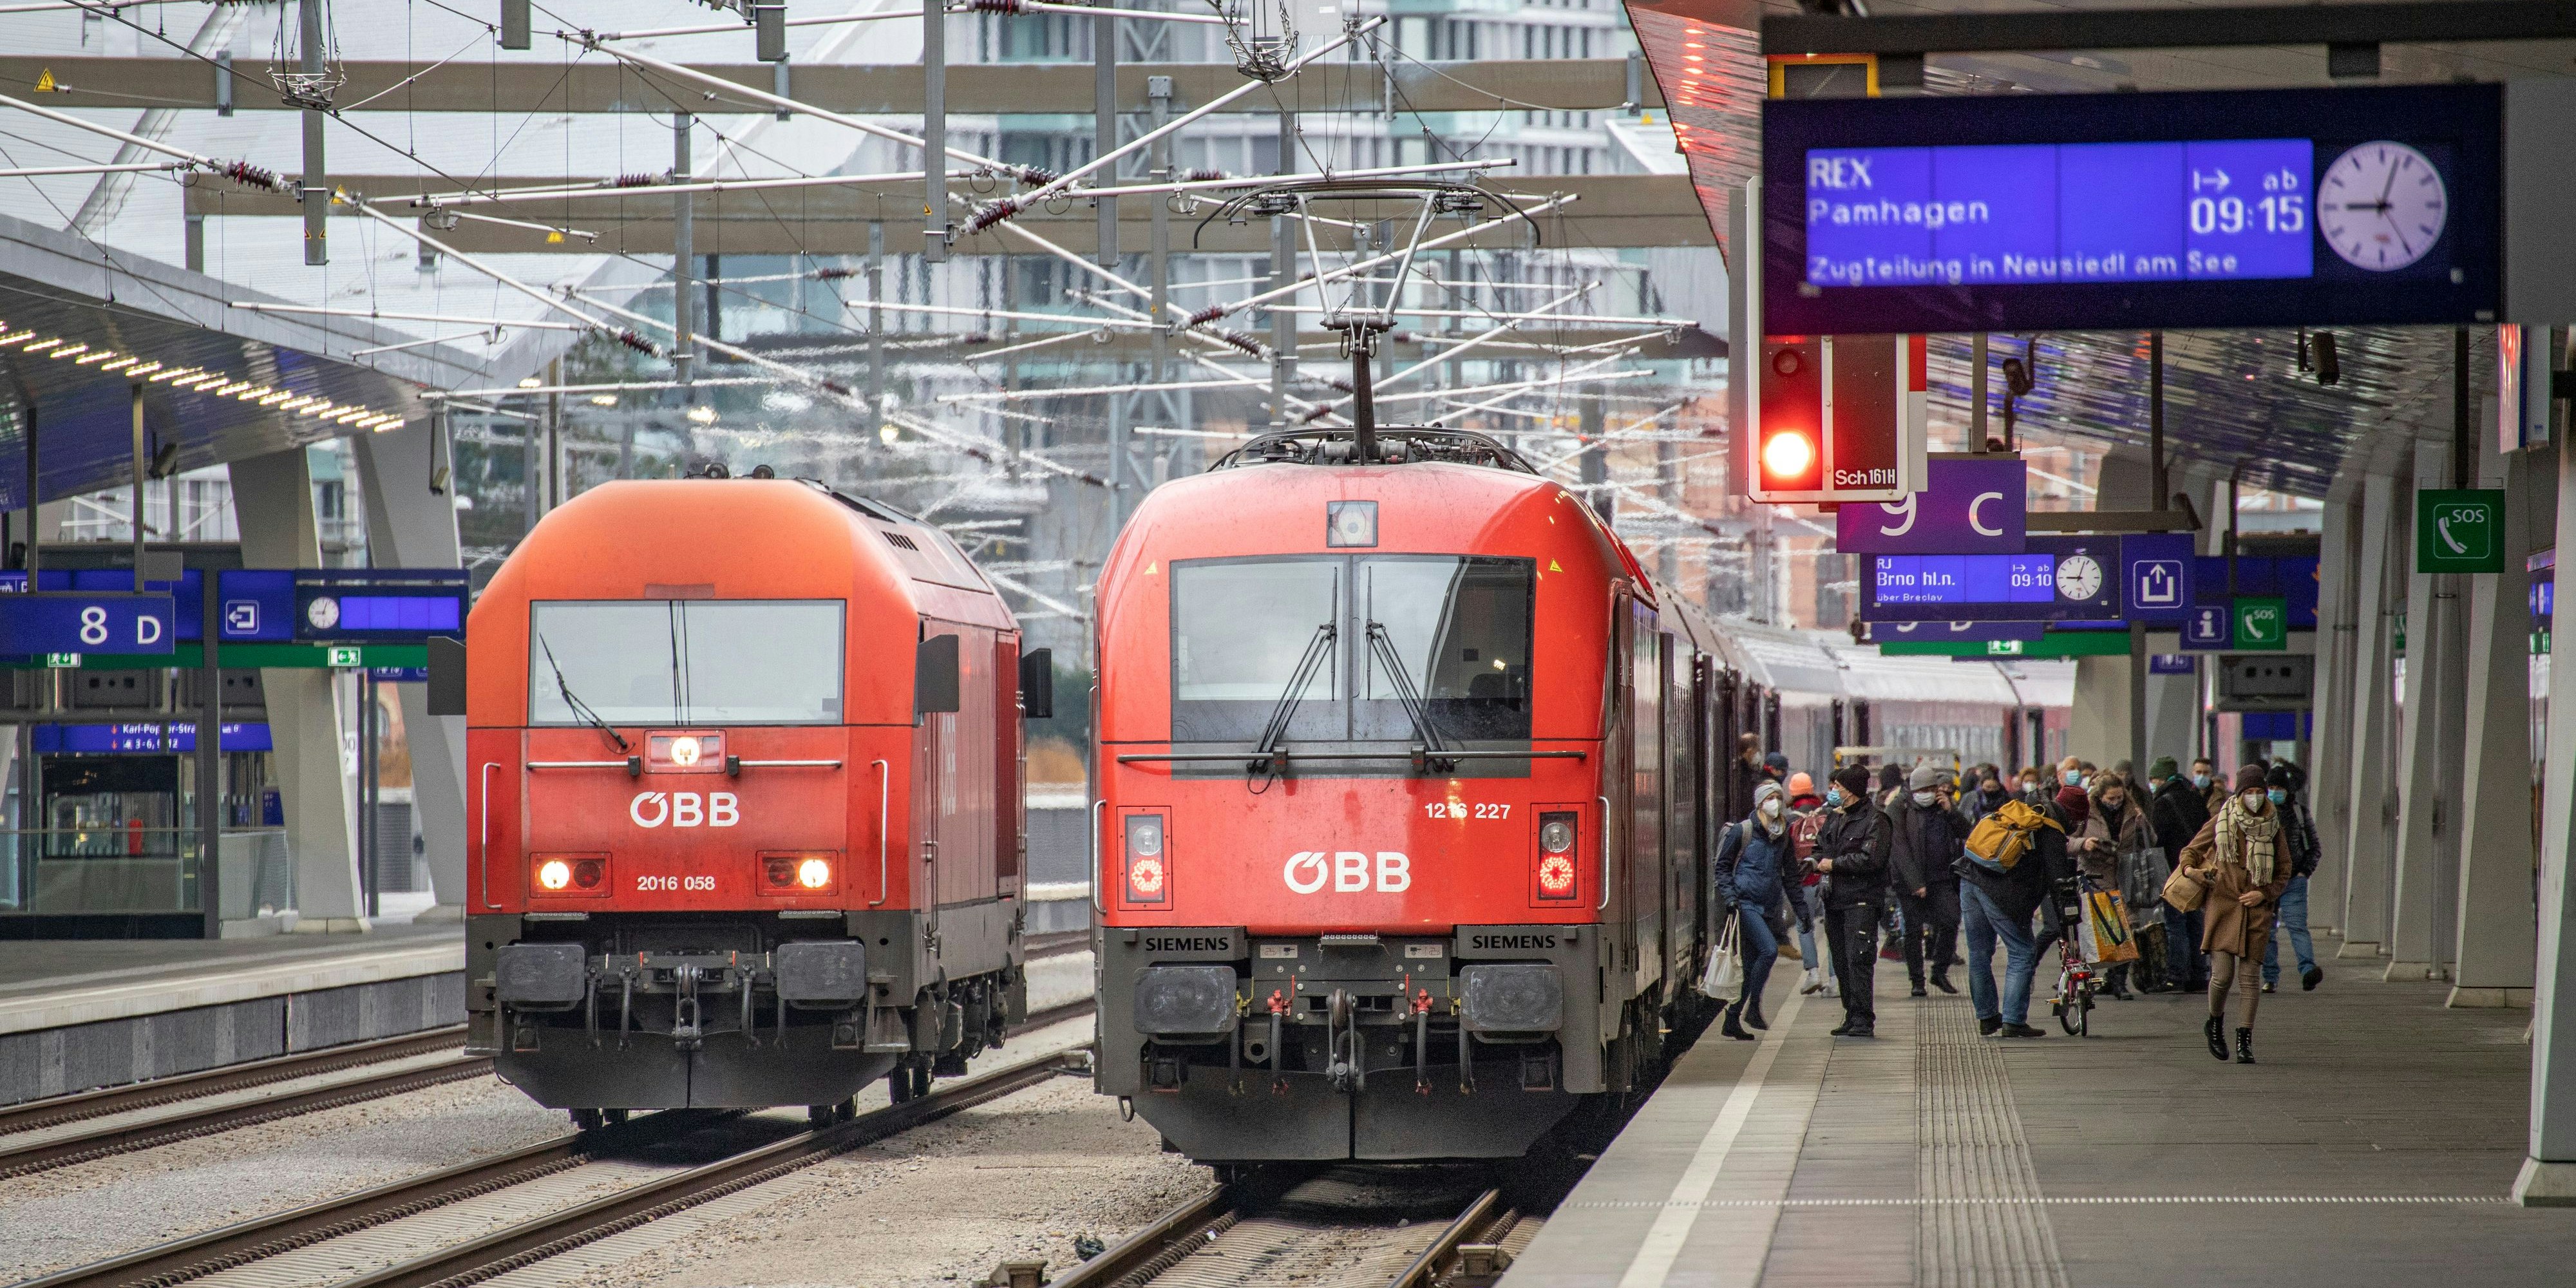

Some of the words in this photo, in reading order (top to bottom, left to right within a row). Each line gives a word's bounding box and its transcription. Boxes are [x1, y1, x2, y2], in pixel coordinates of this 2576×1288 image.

[1810, 158, 1873, 189] REX
[2262, 167, 2298, 191] ab
[1810, 199, 1989, 229] Pamhagen
[2190, 196, 2304, 234] 09:15
[1810, 255, 1963, 285] Zugteilung
[1971, 255, 1995, 276] in
[2003, 252, 2126, 278] Neusiedl
[2134, 256, 2177, 274] am
[2187, 250, 2239, 273] See
[1968, 491, 2003, 536] C
[2452, 509, 2485, 523] SOS
[1877, 558, 1892, 569] RJ
[2037, 564, 2050, 572] ab
[1877, 572, 1915, 586] Brno
[1922, 571, 1956, 586] hl.n.
[2011, 573, 2052, 587] 09:10
[1877, 593, 1899, 601] über
[1903, 592, 1943, 601] Breclav
[2253, 609, 2275, 620] SOS
[80, 606, 108, 645] 8
[137, 616, 160, 644] D
[630, 791, 739, 828] ÖBB
[1475, 803, 1511, 819] 227
[1283, 851, 1411, 895] ÖBB
[637, 876, 678, 891] 2016
[684, 876, 715, 891] 058
[1146, 937, 1229, 952] SIEMENS
[1472, 935, 1556, 949] SIEMENS
